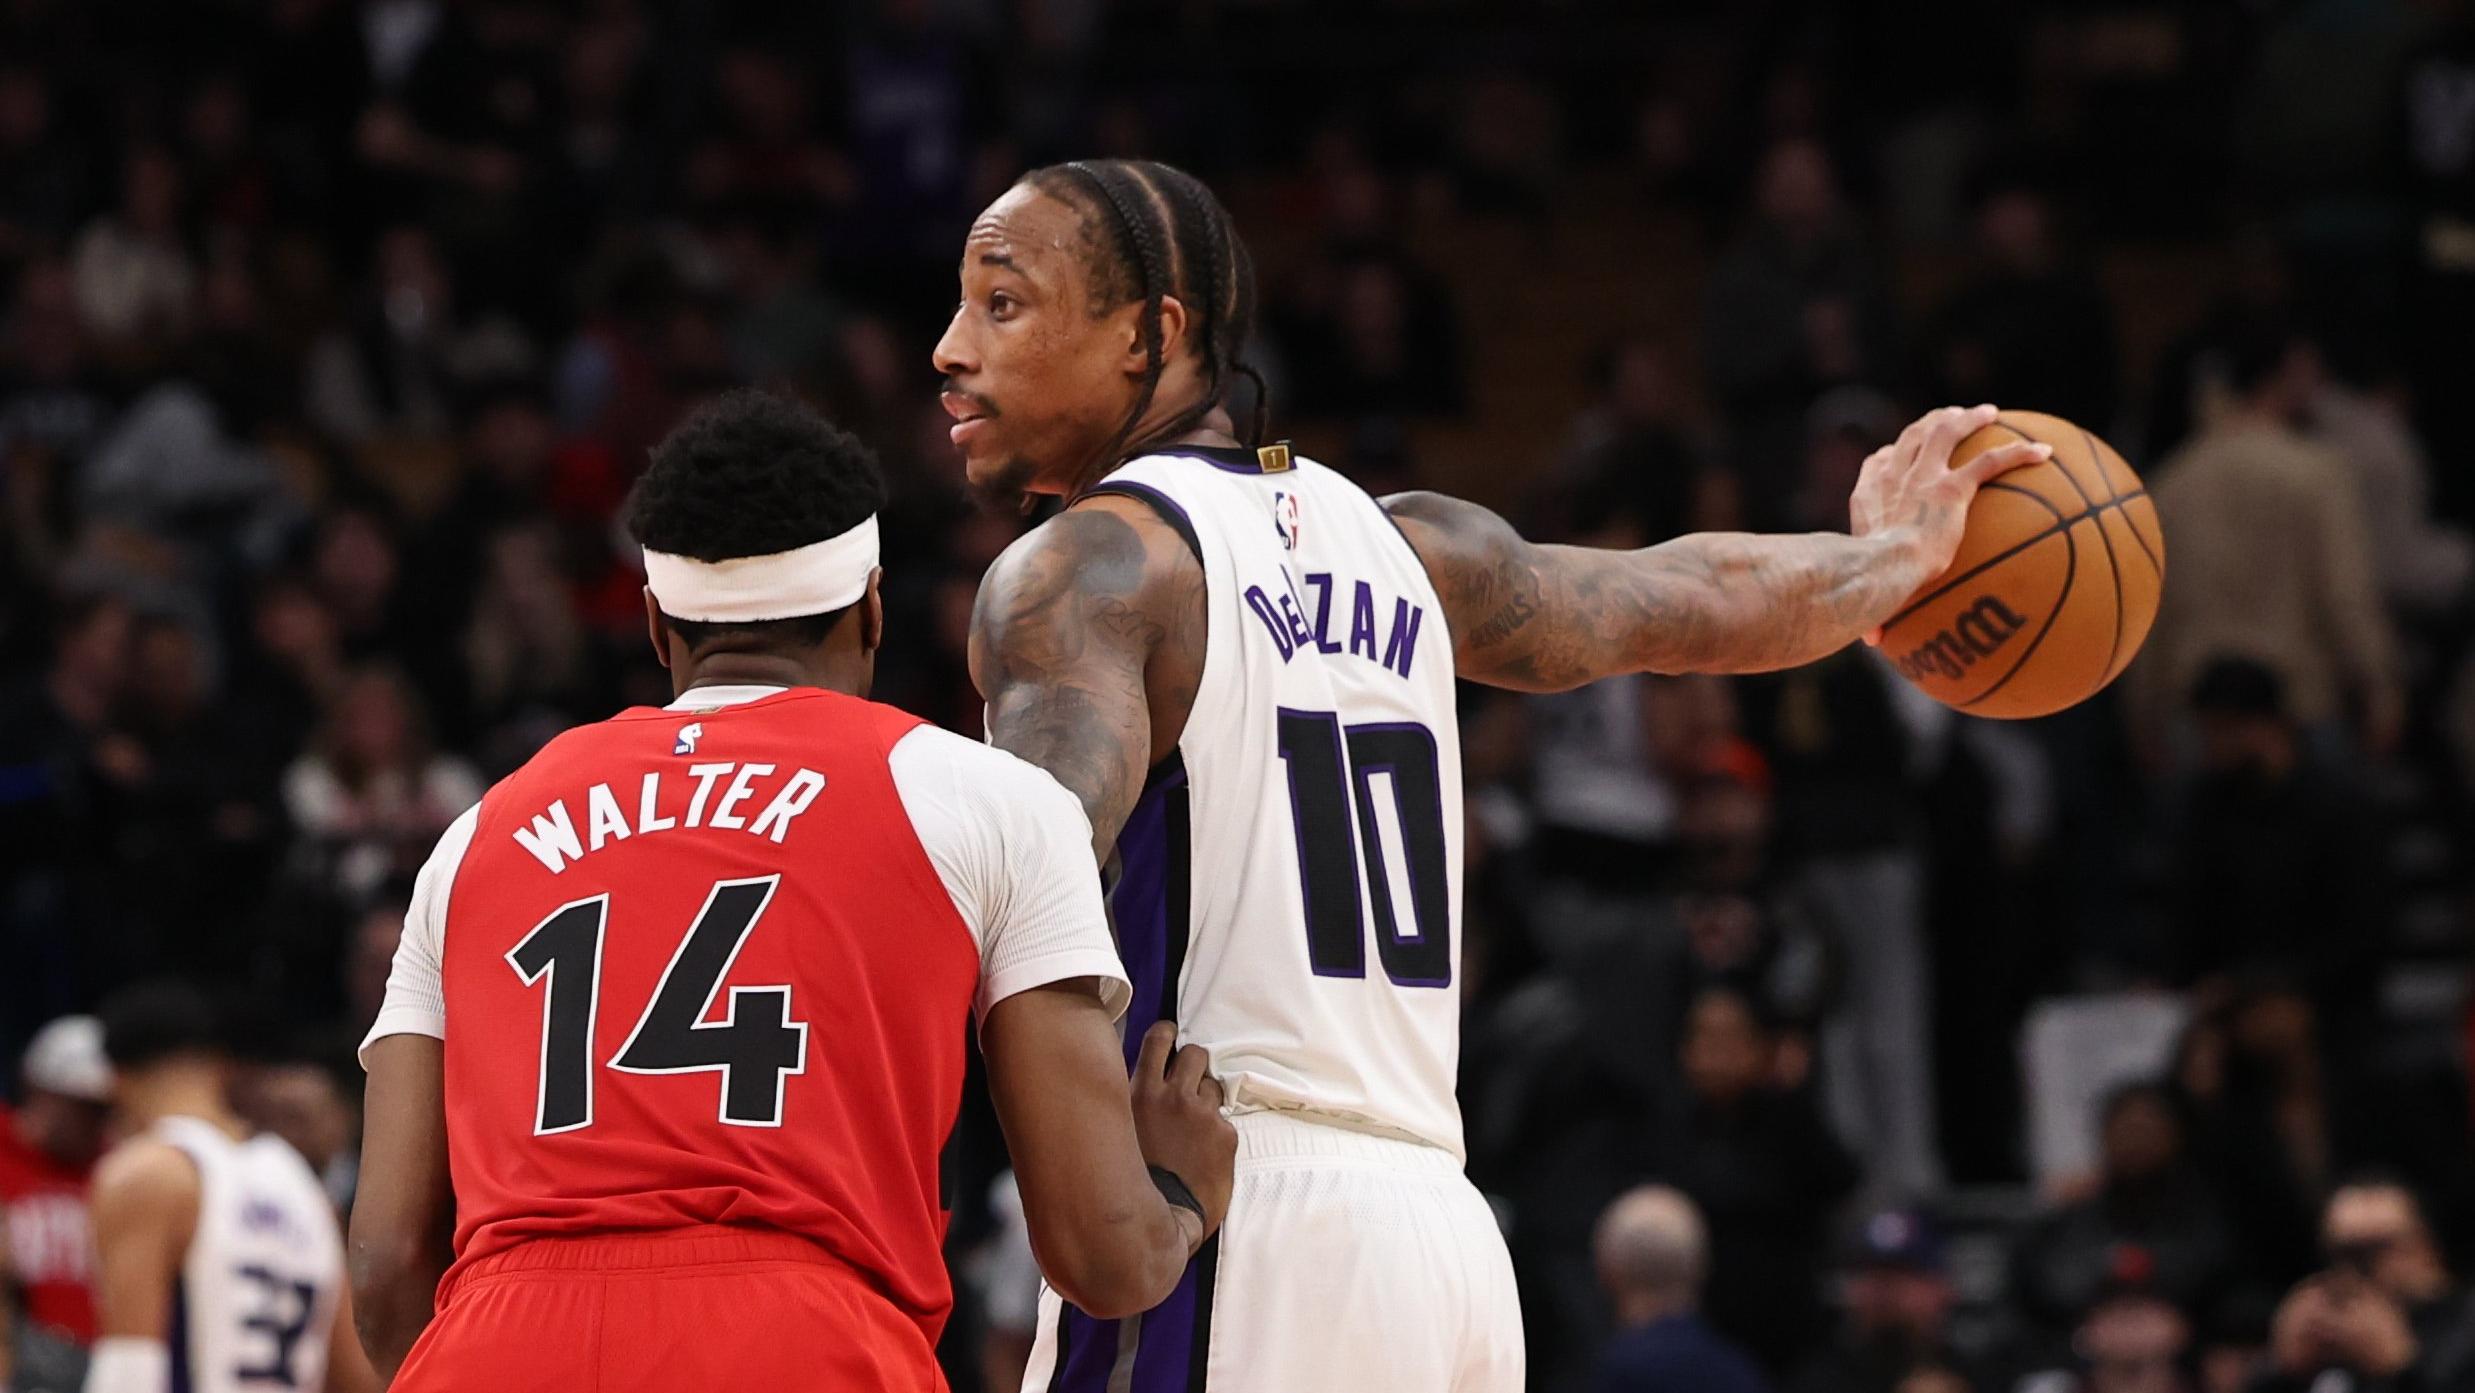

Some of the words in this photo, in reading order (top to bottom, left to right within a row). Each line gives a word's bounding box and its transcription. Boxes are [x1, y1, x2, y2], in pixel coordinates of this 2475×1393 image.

[1244, 564, 1423, 681] DEZAN
[512, 762, 826, 874] WALTER
[1276, 705, 1452, 989] 10
[504, 873, 809, 1137] 14
